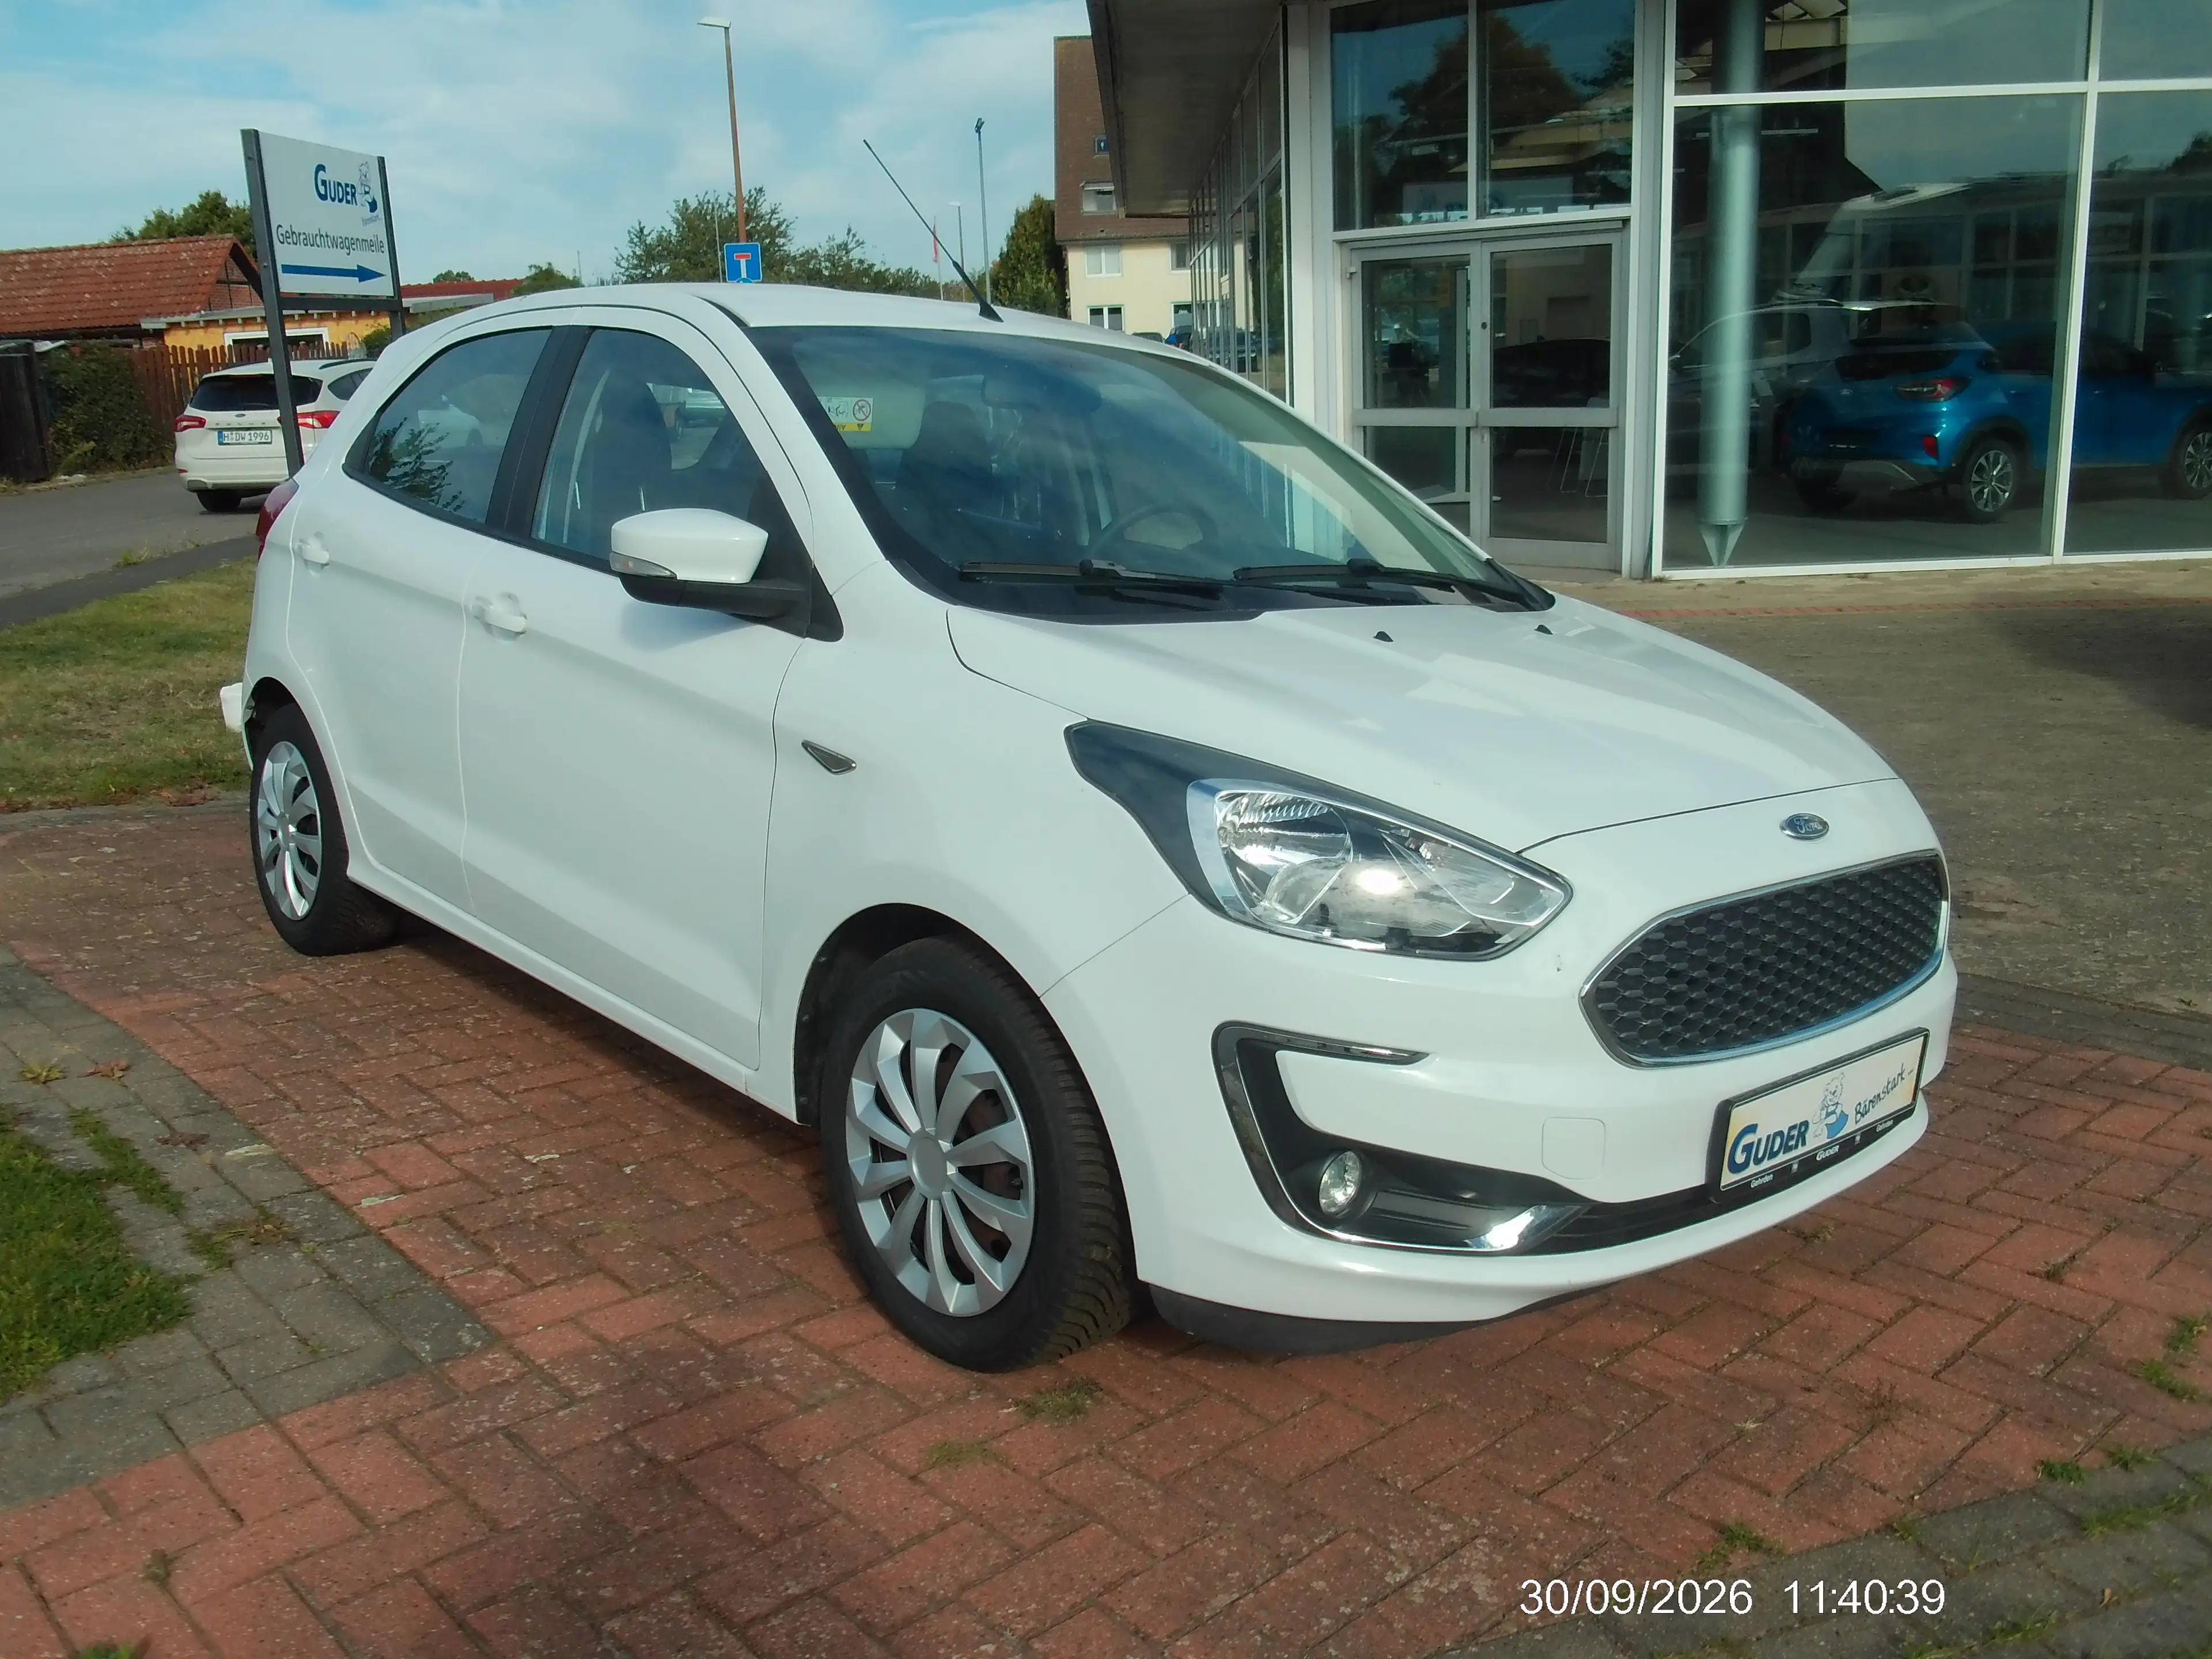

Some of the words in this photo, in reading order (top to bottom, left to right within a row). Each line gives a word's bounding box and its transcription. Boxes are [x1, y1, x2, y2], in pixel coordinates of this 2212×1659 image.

[314, 164, 358, 206] GUDER
[276, 224, 385, 256] Gebrauchtwagenmeile
[248, 432, 269, 441] 1996
[1794, 816, 1823, 834] Ford
[1728, 1119, 1809, 1174] GUDER
